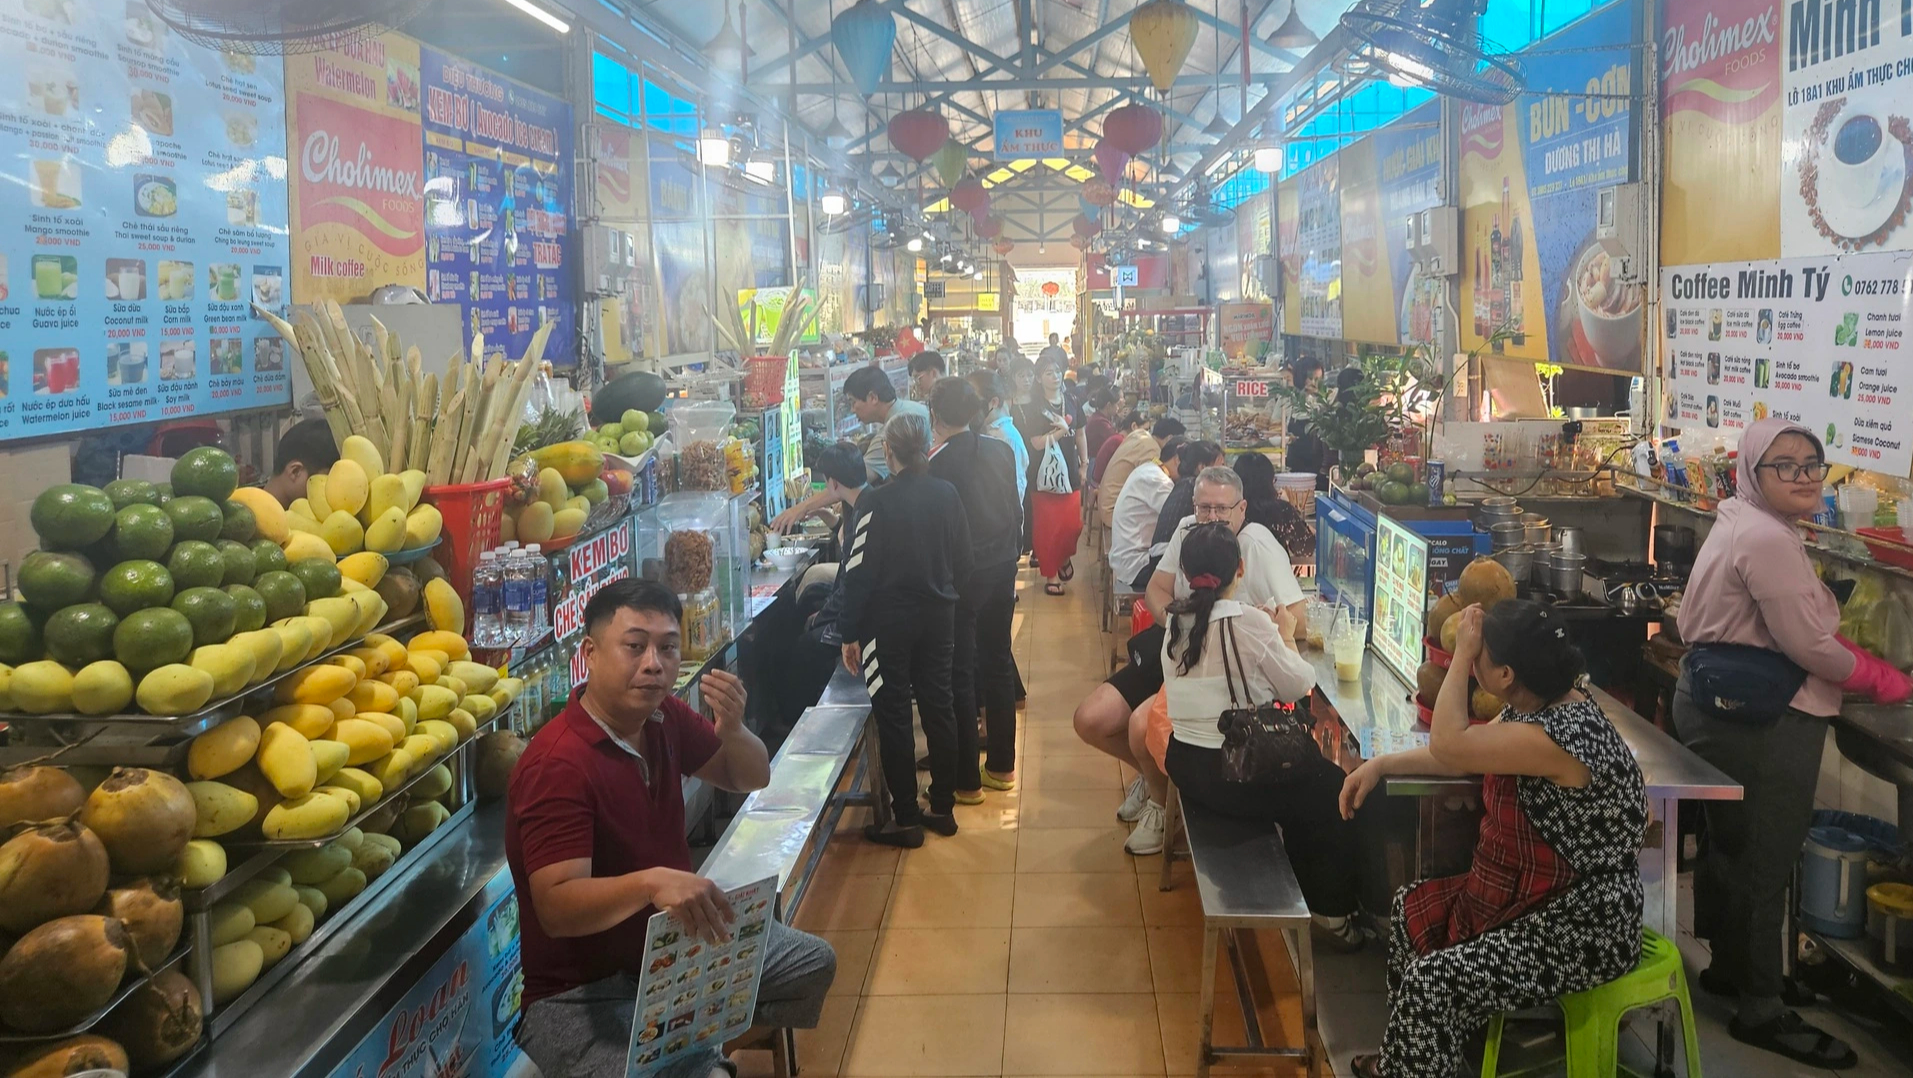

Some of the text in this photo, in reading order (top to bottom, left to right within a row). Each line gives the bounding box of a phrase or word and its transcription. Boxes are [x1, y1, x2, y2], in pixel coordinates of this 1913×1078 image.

[1662, 5, 1775, 80] Cholimex
[1725, 48, 1767, 76] FOODS
[315, 55, 376, 100] Watermelon
[1788, 87, 1799, 106] LÔ
[1801, 83, 1822, 103] 18A1
[1826, 77, 1845, 97] KHU
[1848, 67, 1864, 91] ẨM
[1866, 62, 1893, 86] THỰC
[428, 85, 453, 128] KEM
[454, 94, 469, 132] BƠ
[477, 102, 514, 145] Avocado
[514, 114, 529, 149] ice
[529, 123, 554, 156] cream
[1461, 102, 1502, 135] Cholimex
[1015, 129, 1042, 138] KHU
[1001, 138, 1058, 153] ẨM THỰC
[1545, 127, 1621, 175] DƯƠNG THỊ HÀ
[302, 129, 421, 200] Cholimex
[382, 198, 415, 213] FOODS
[32, 214, 83, 226] Sinh tố xoài
[25, 225, 90, 237] Mango smoothie
[115, 231, 196, 244] Thai sweet soup durian
[311, 255, 365, 277] Milk coffee
[1672, 266, 1831, 302] Coffee Minh Tý
[1855, 280, 1877, 296] 0762
[1880, 279, 1899, 295] 778
[35, 306, 67, 317] Nước ép
[33, 319, 79, 329] Guava juice
[104, 316, 149, 325] Coconut milk
[163, 315, 192, 324] Corn milk
[204, 315, 220, 323] Green
[221, 315, 235, 323] bean
[107, 328, 146, 338] 20,000 VND
[160, 326, 195, 336] 15,000 VND
[1777, 332, 1804, 341] 20,000 VND
[1865, 328, 1903, 339] Lemon juice
[1885, 341, 1900, 350] VND
[1775, 372, 1820, 382] Avocado smoothie
[1237, 382, 1268, 396] RICE
[1775, 381, 1802, 391] 30,000 VND
[1859, 382, 1898, 394] Orange juice
[22, 394, 91, 412] Nước ép dưa hấu
[97, 397, 158, 411] Black sesame milk
[165, 394, 190, 405] Soy milk
[1857, 393, 1891, 405] 25,000 VND
[161, 404, 195, 415] 10,000 VND
[22, 410, 91, 425] Watermelon juice
[110, 411, 147, 422] 15,000 VND
[1852, 433, 1901, 450] Siamese Coconut
[1869, 449, 1881, 459] VND
[572, 535, 607, 582] KEM
[609, 522, 629, 562] BƠ
[1451, 545, 1469, 554] CHẤT
[555, 591, 577, 640] CHÈ
[380, 961, 467, 1078] Loan
[402, 992, 469, 1073] THỰC CHỢ HÀN
